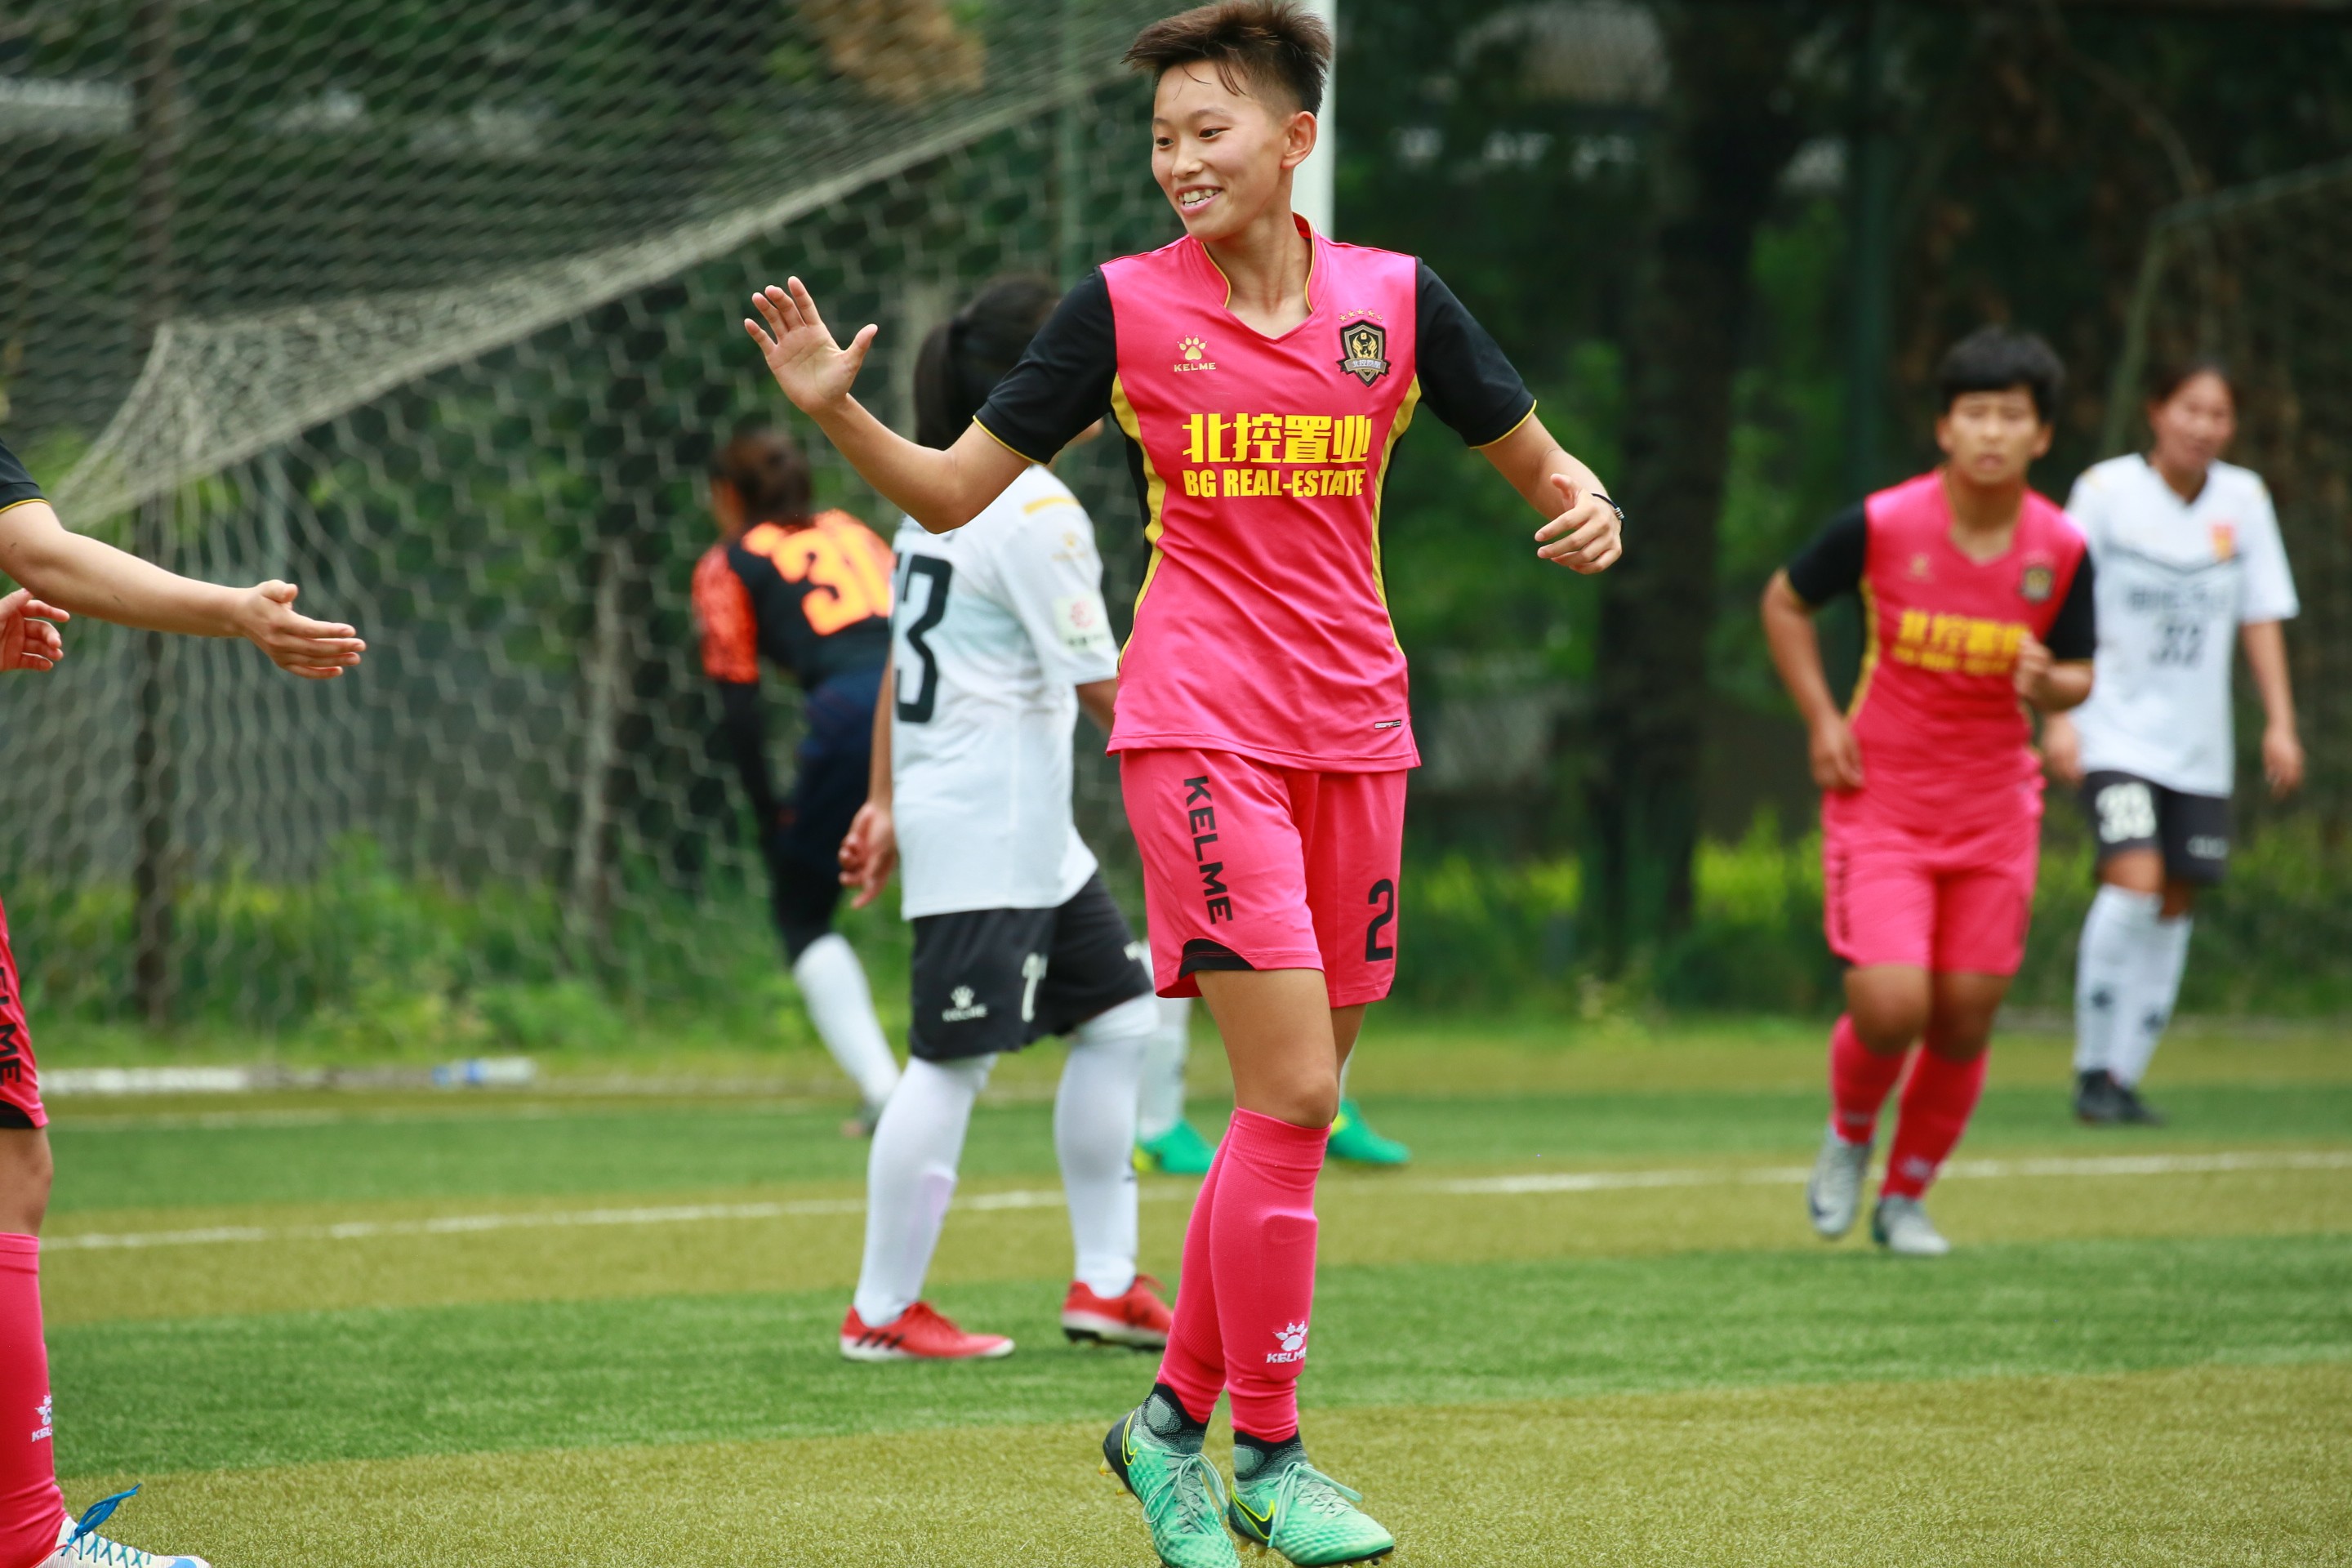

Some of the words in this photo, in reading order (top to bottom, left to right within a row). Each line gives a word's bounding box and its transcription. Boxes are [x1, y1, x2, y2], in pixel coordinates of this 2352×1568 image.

[1174, 362, 1217, 372] KELME
[1182, 412, 1372, 463] 北控置业
[1183, 469, 1217, 497] BG
[1223, 469, 1366, 497] REAL-ESTATE
[895, 551, 953, 724] 3
[1183, 775, 1233, 925] KELME
[1365, 878, 1394, 962] 2
